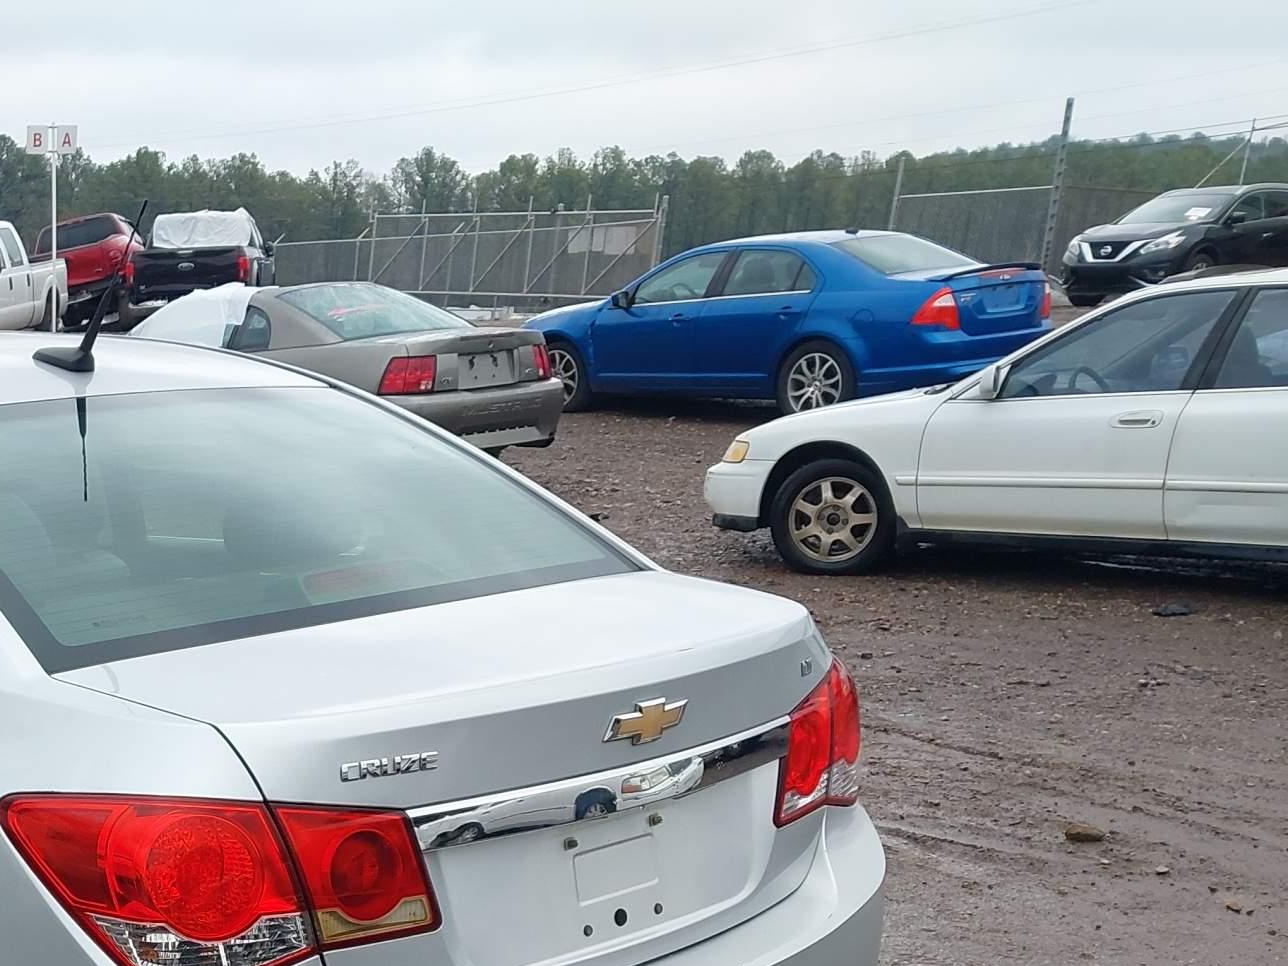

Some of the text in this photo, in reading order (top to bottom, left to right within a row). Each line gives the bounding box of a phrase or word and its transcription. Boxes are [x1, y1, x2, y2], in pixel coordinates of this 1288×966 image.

[33, 132, 42, 147] B
[62, 132, 72, 147] A
[339, 751, 439, 782] CRUZE
